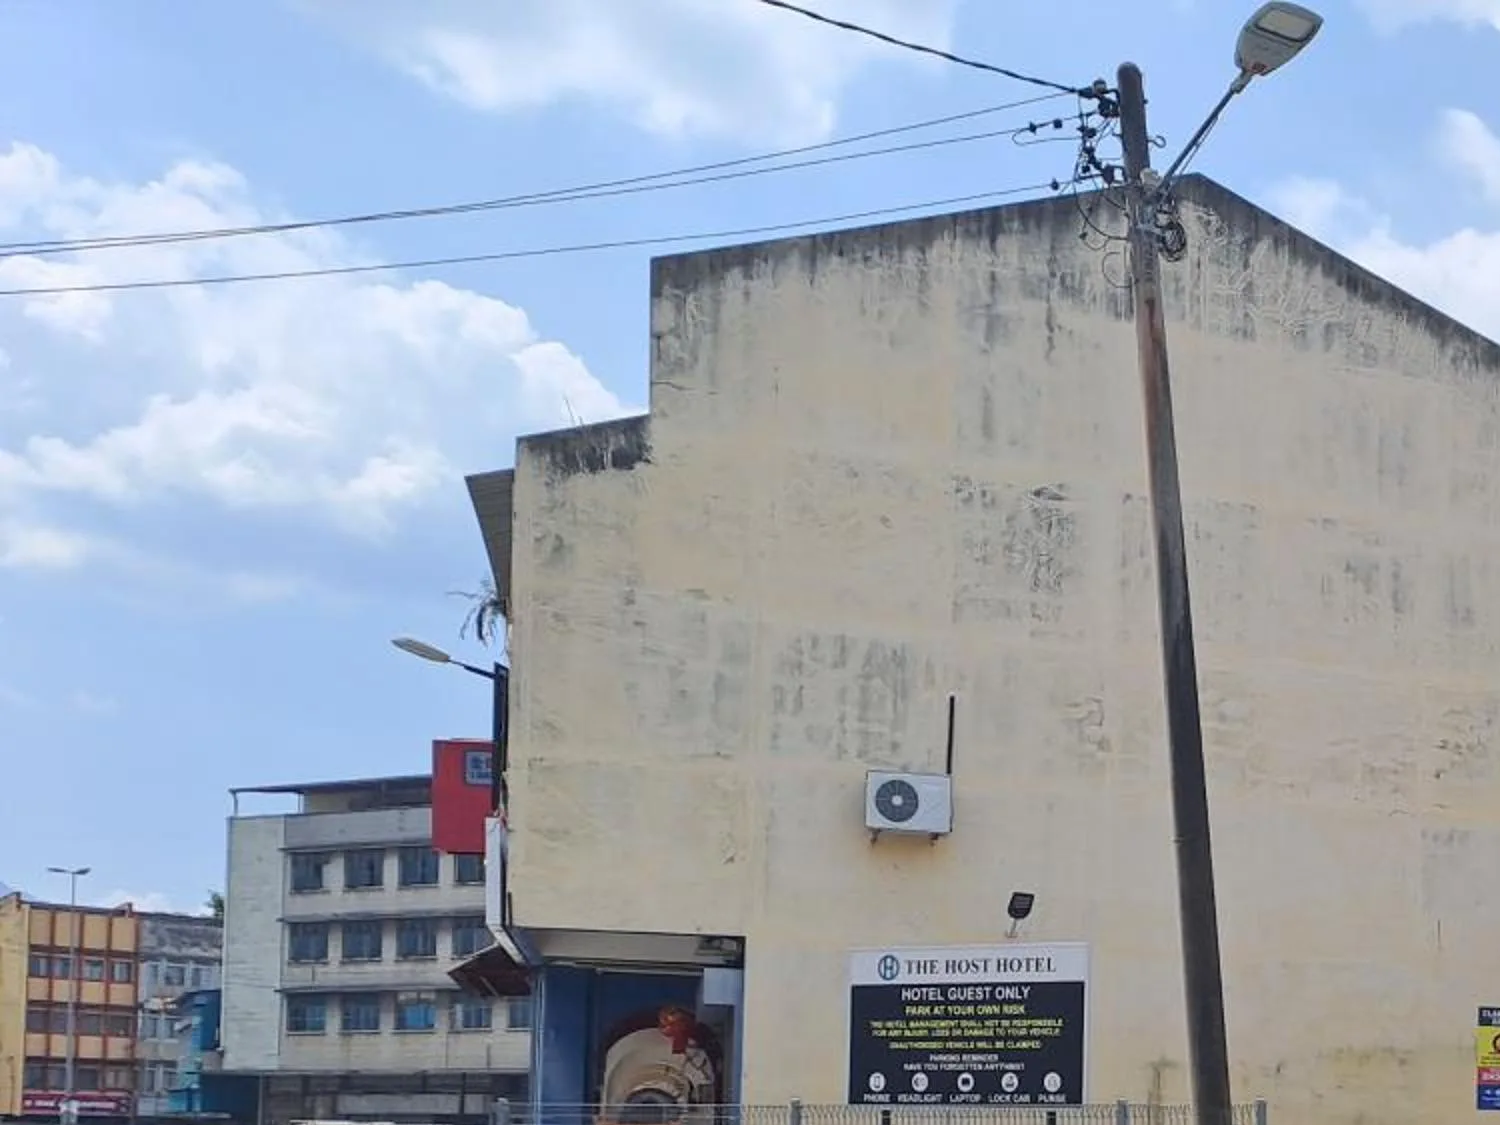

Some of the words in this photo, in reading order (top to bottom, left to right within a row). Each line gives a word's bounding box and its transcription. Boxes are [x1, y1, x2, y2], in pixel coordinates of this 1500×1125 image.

[906, 959, 939, 975] THE
[945, 959, 993, 974] HOST
[997, 957, 1056, 972] HOTEL
[901, 986, 945, 1001] HOTEL
[947, 986, 992, 1000] GUEST
[995, 985, 1031, 1000] ONLY
[905, 1005, 931, 1016] PARK
[933, 1005, 945, 1015] AT
[946, 1005, 975, 1015] YOUR
[976, 1004, 1001, 1015] OWN
[1002, 1004, 1025, 1014] RISK
[949, 1093, 981, 1102] LAPTOP
